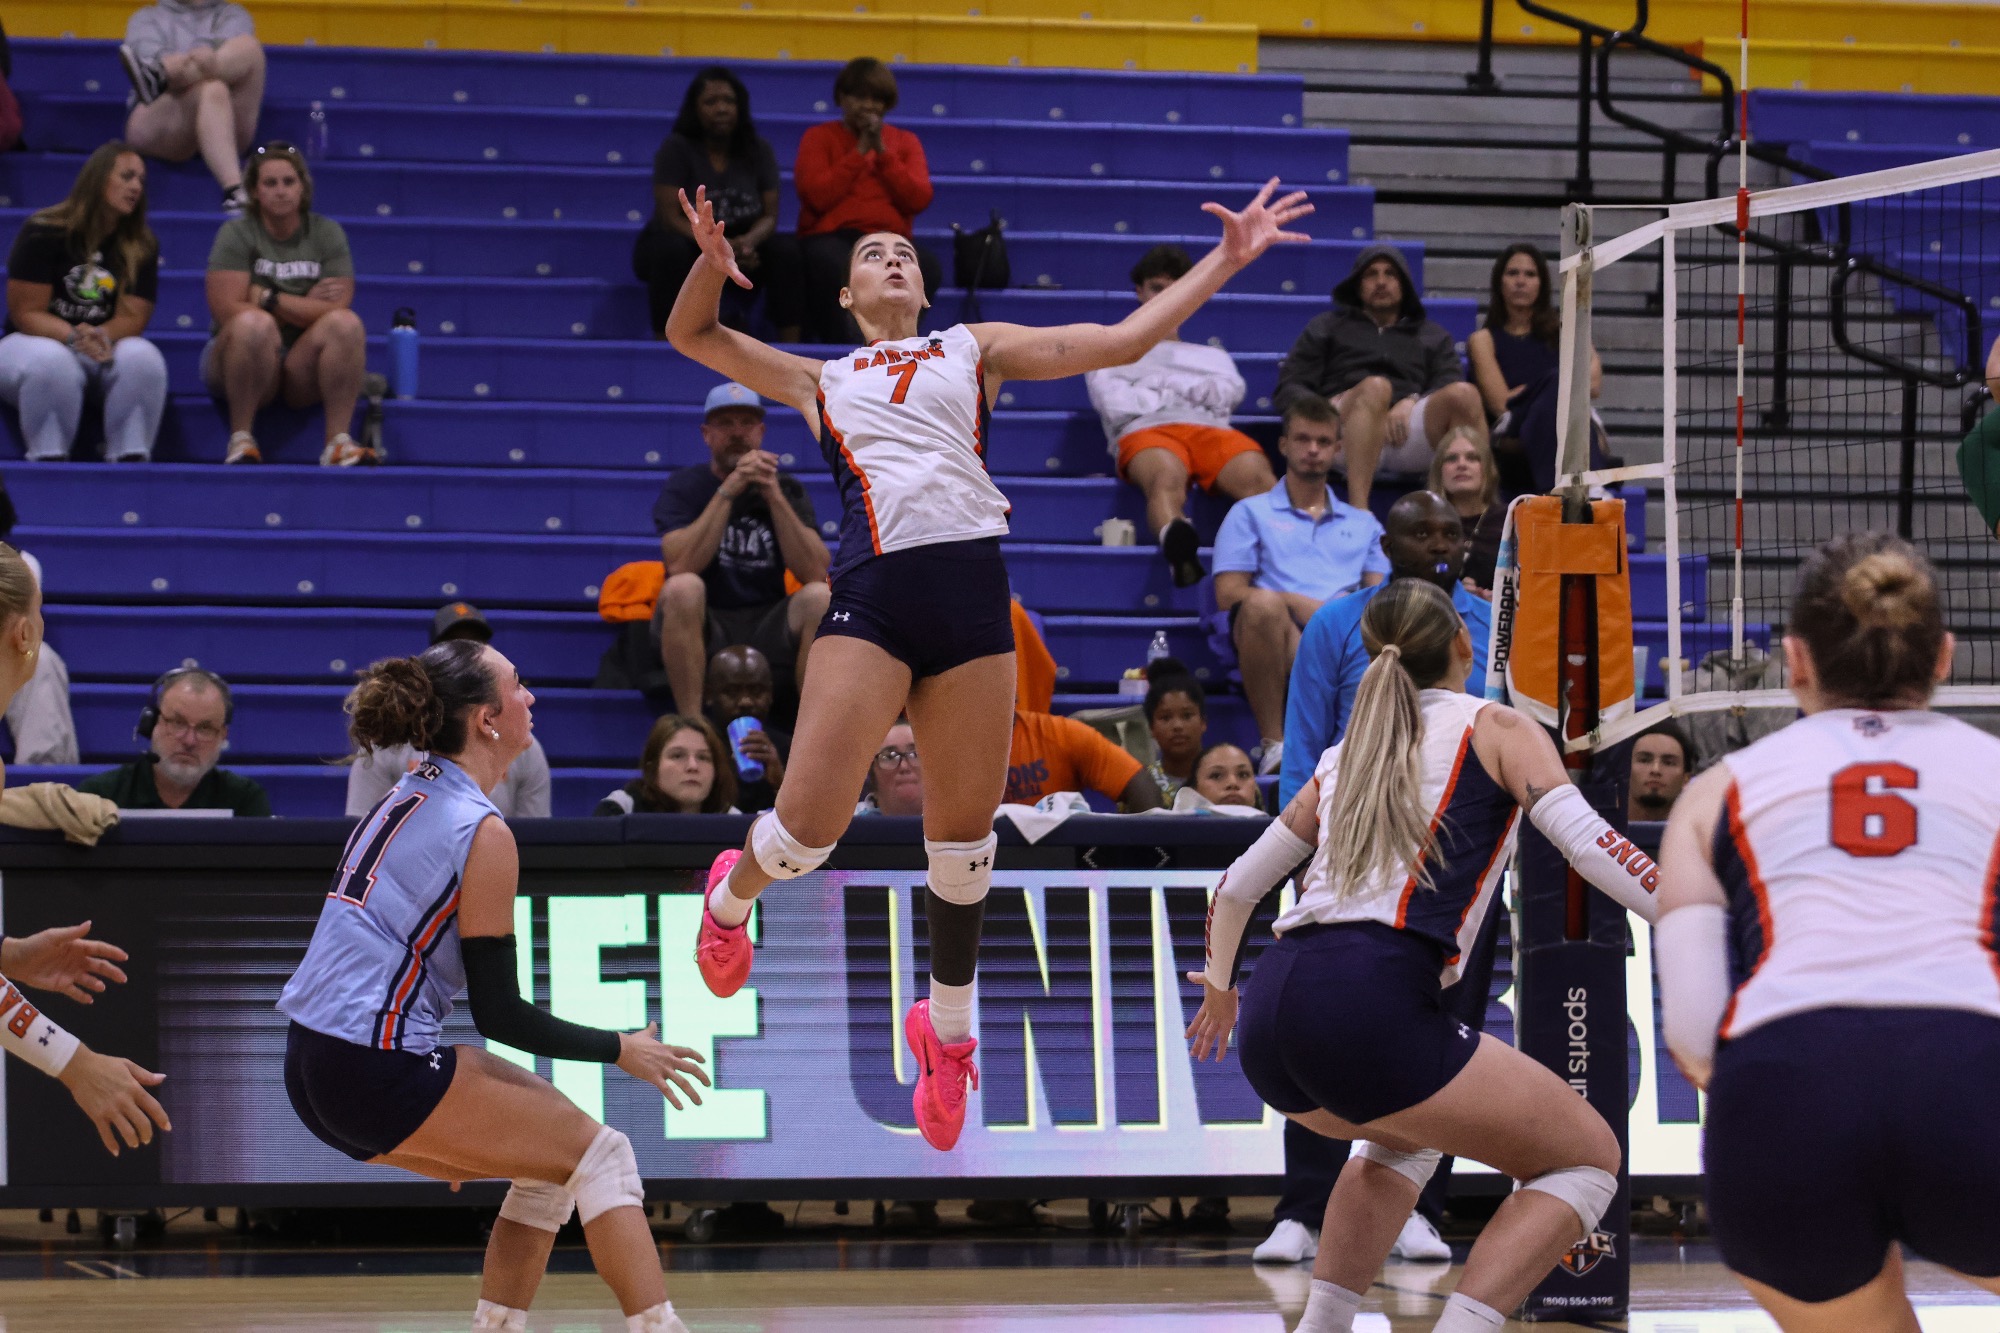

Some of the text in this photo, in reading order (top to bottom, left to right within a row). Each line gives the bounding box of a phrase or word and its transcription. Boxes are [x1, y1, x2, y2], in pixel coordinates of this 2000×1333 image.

[886, 358, 918, 404] 7
[1493, 575, 1515, 672] POWERADE
[326, 786, 429, 909] 11
[1829, 760, 1920, 857] 6
[0, 975, 39, 1039] BA
[1562, 986, 1591, 1073] sports
[1542, 1296, 1568, 1306] (800)
